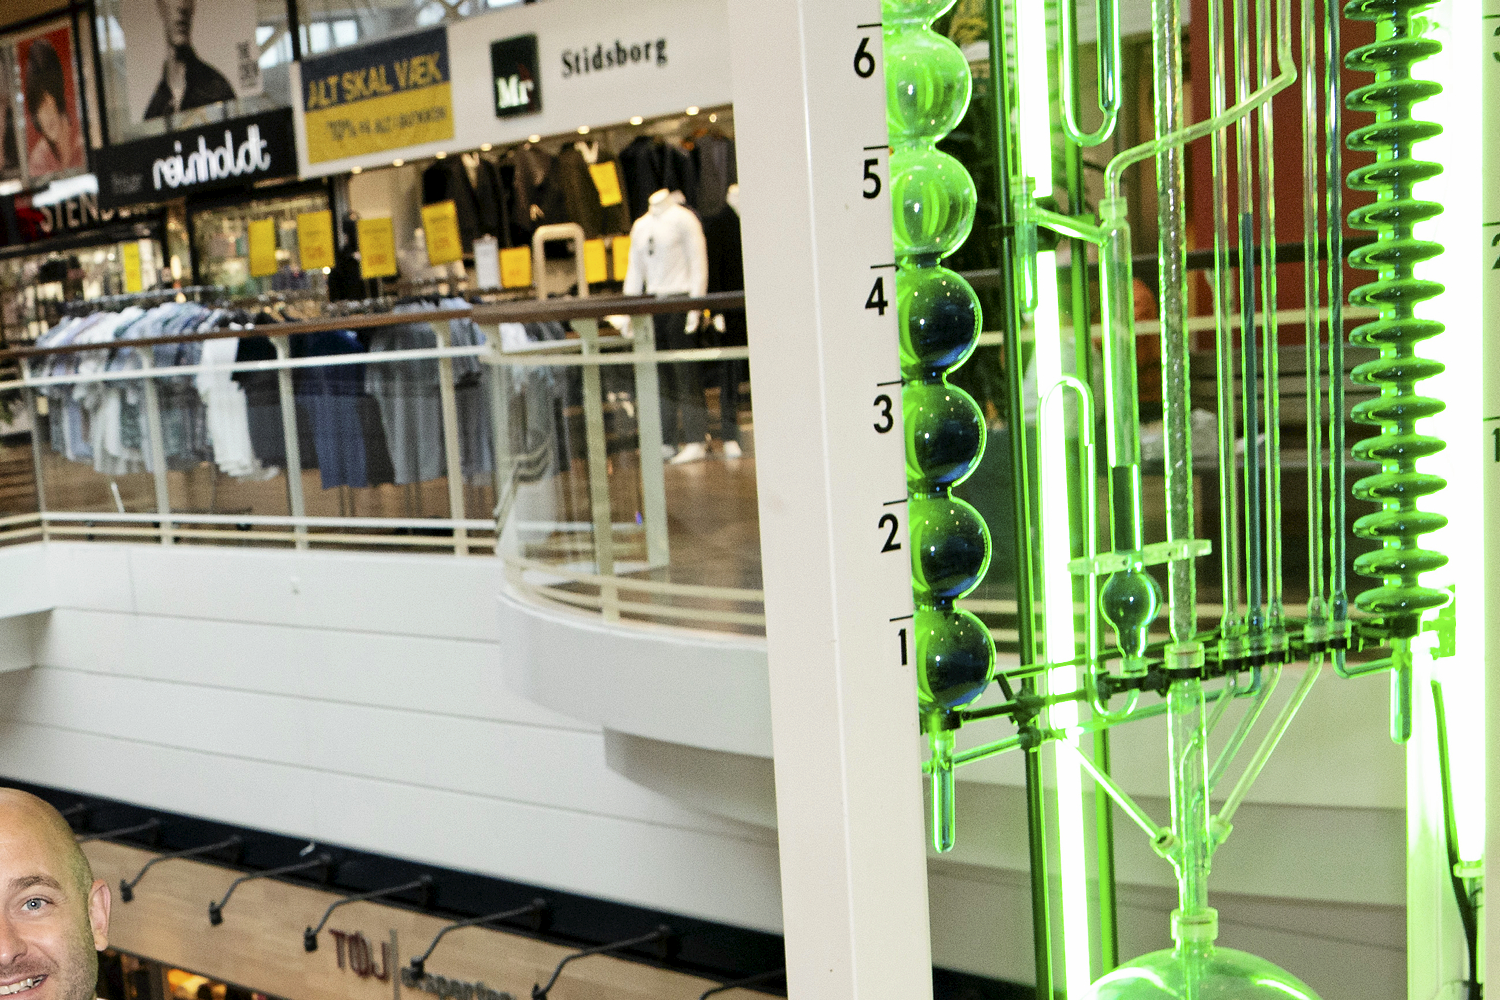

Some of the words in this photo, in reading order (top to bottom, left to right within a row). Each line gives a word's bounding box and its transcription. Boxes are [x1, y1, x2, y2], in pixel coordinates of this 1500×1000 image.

[561, 37, 668, 78] Stidsborg
[853, 37, 876, 78] 6
[307, 74, 339, 110] ALT
[341, 65, 393, 101] SKAL
[393, 51, 443, 88] VÆK
[496, 74, 534, 109] Mr
[152, 124, 271, 190] reinholdt
[862, 158, 882, 199] 5
[865, 277, 888, 316] 4
[873, 394, 894, 433] 3
[878, 513, 901, 553] 2
[898, 628, 908, 666] 1
[329, 927, 390, 982] TØJ
